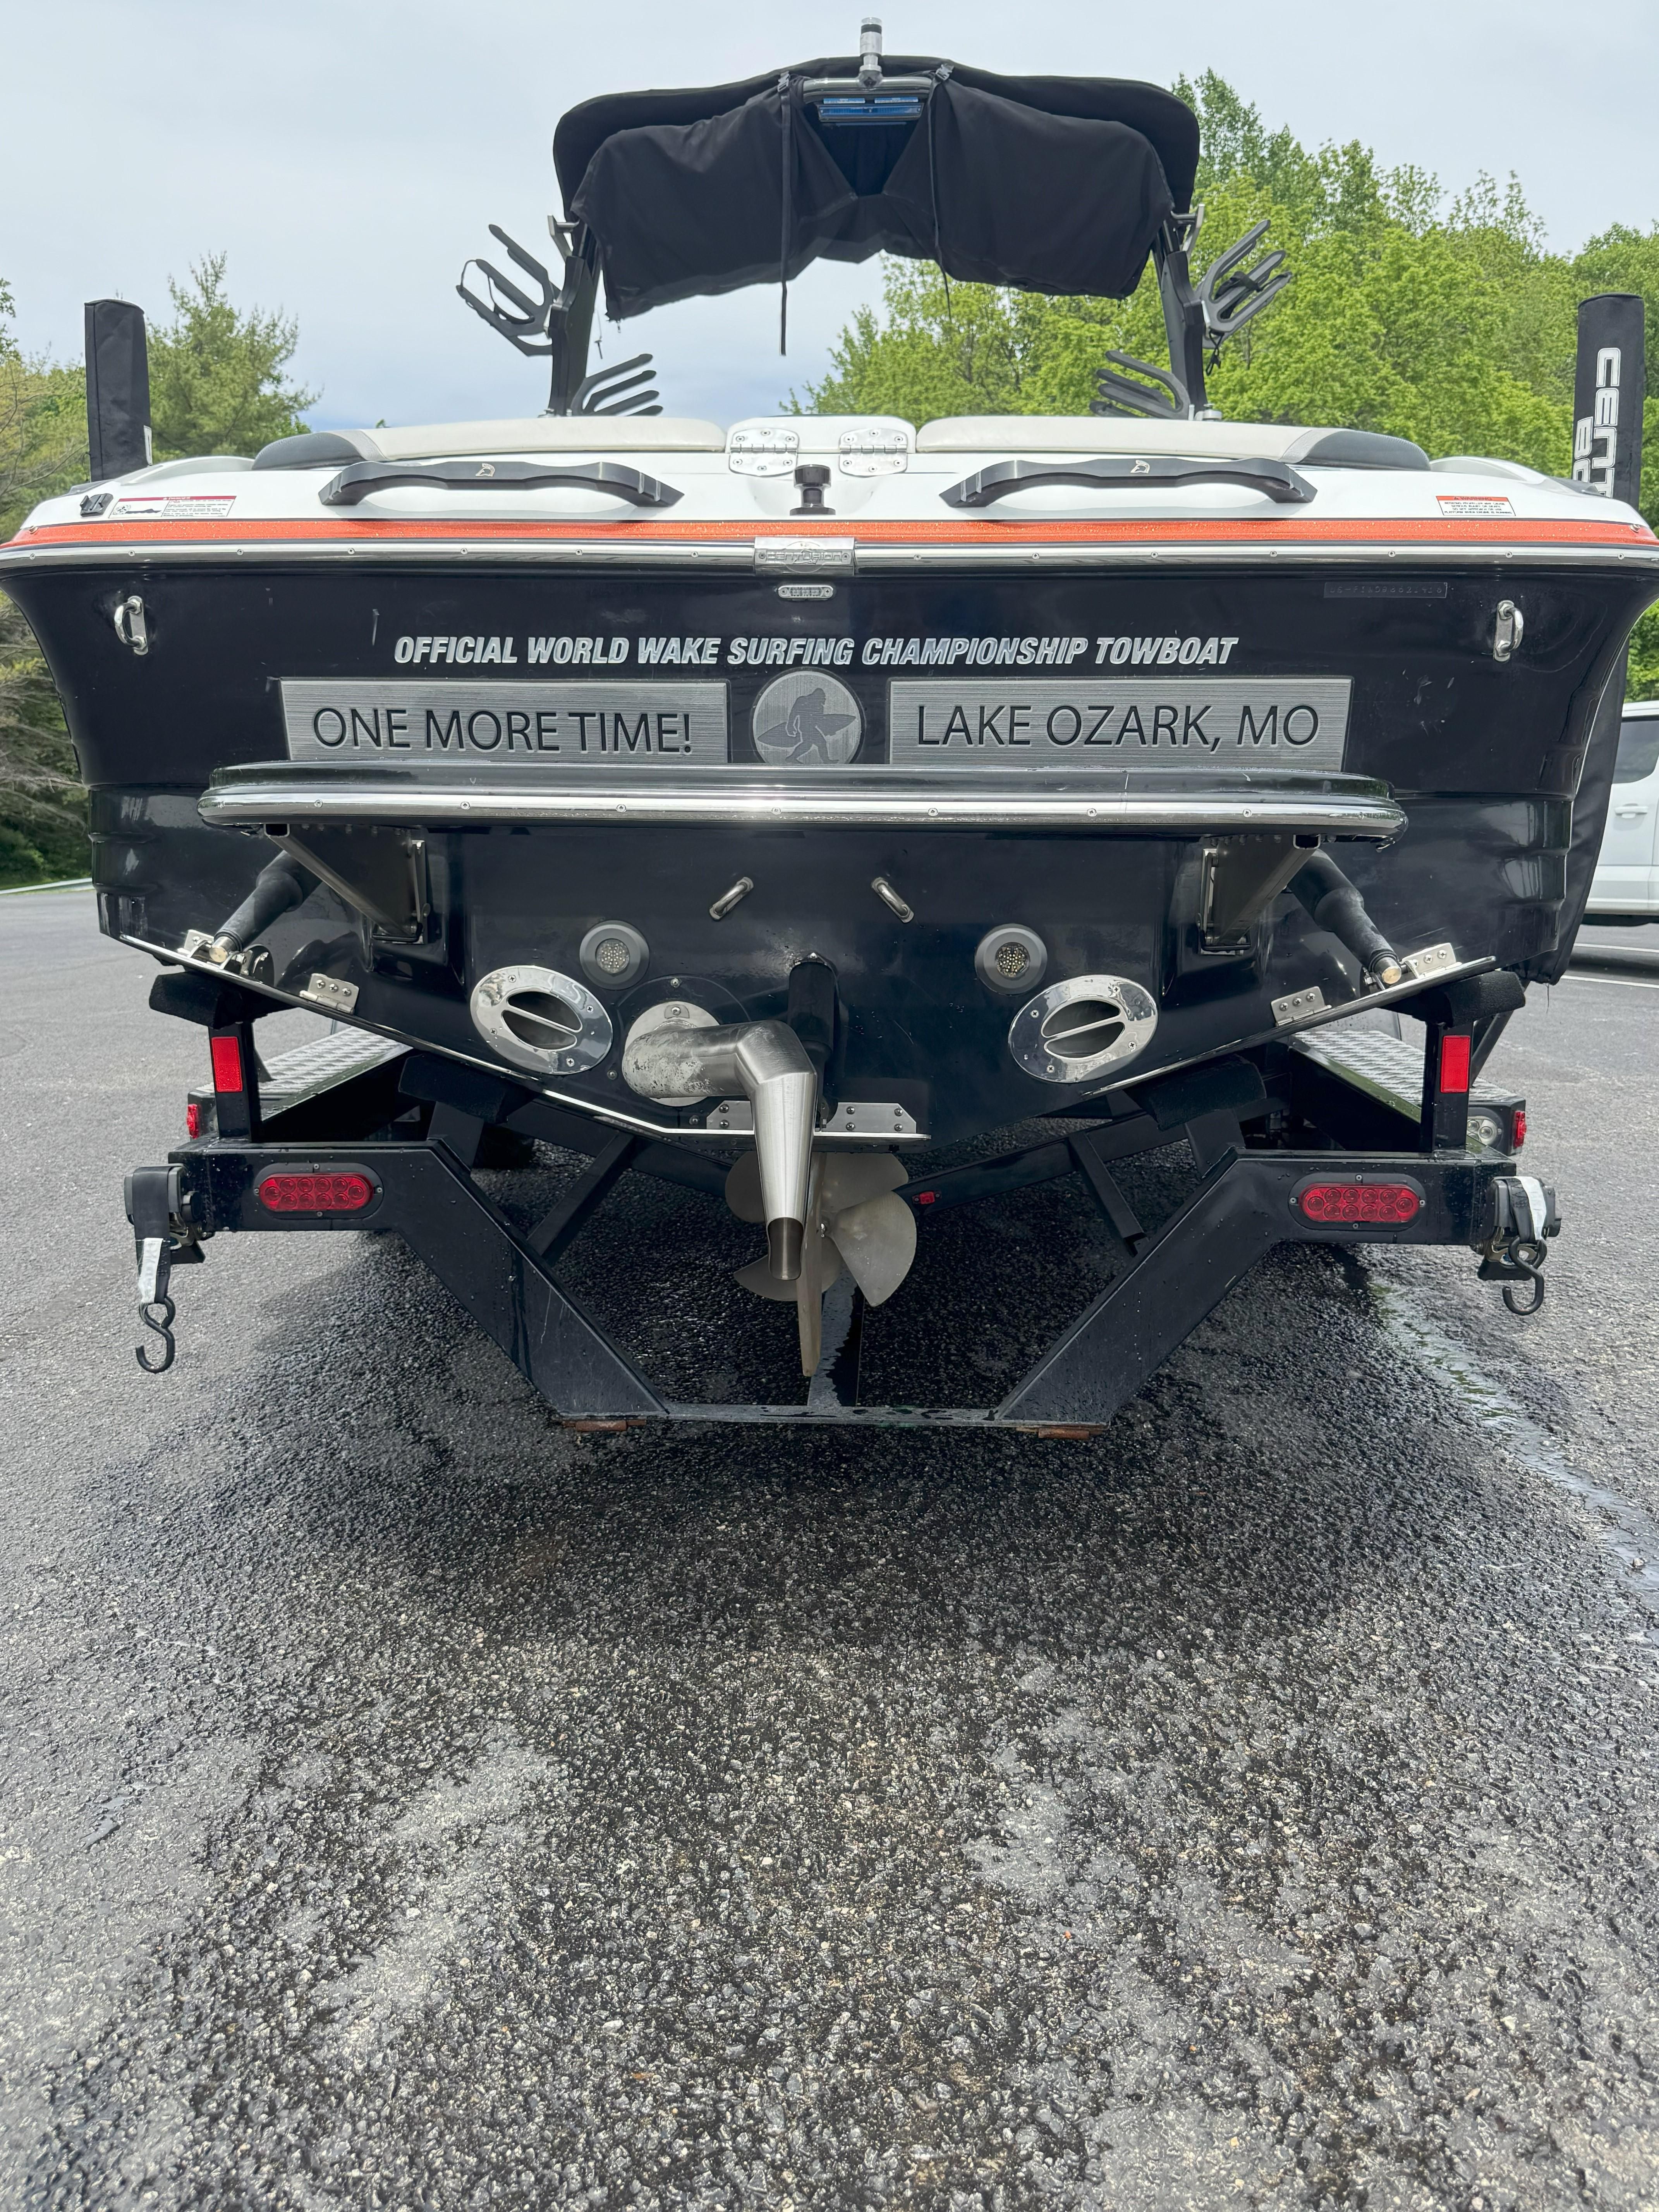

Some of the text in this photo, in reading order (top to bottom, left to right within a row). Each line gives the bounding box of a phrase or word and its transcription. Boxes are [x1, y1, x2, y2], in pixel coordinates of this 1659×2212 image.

[394, 636, 1239, 665] OFFICIAL WORLD WAKE SURFING CHAMPIONSHIP TOWBOAT
[313, 708, 692, 754] ONE MORE TIME!
[918, 705, 1319, 753] LAKE OZARK, MO
